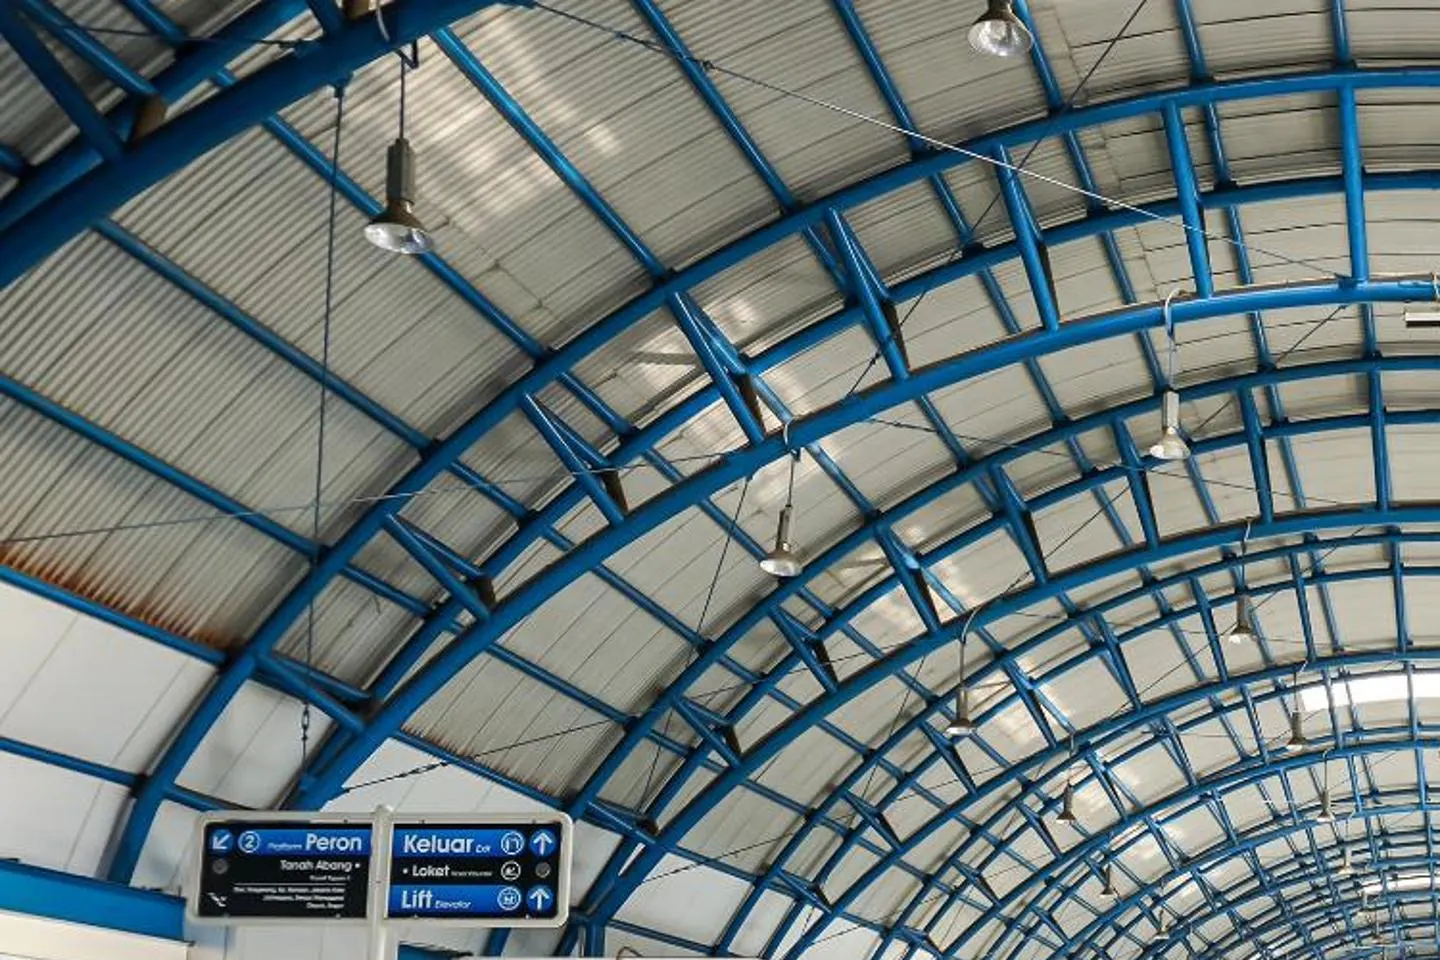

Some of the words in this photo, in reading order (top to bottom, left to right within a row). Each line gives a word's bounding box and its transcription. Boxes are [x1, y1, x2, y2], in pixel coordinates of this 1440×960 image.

[244, 835, 254, 849] 2
[306, 833, 362, 851] Peron
[403, 834, 475, 853] Keluar
[280, 860, 314, 871] Tanah
[315, 860, 352, 873] Abang
[412, 865, 450, 877] Loket
[401, 889, 433, 909] Lift
[434, 900, 471, 909] Elevator
